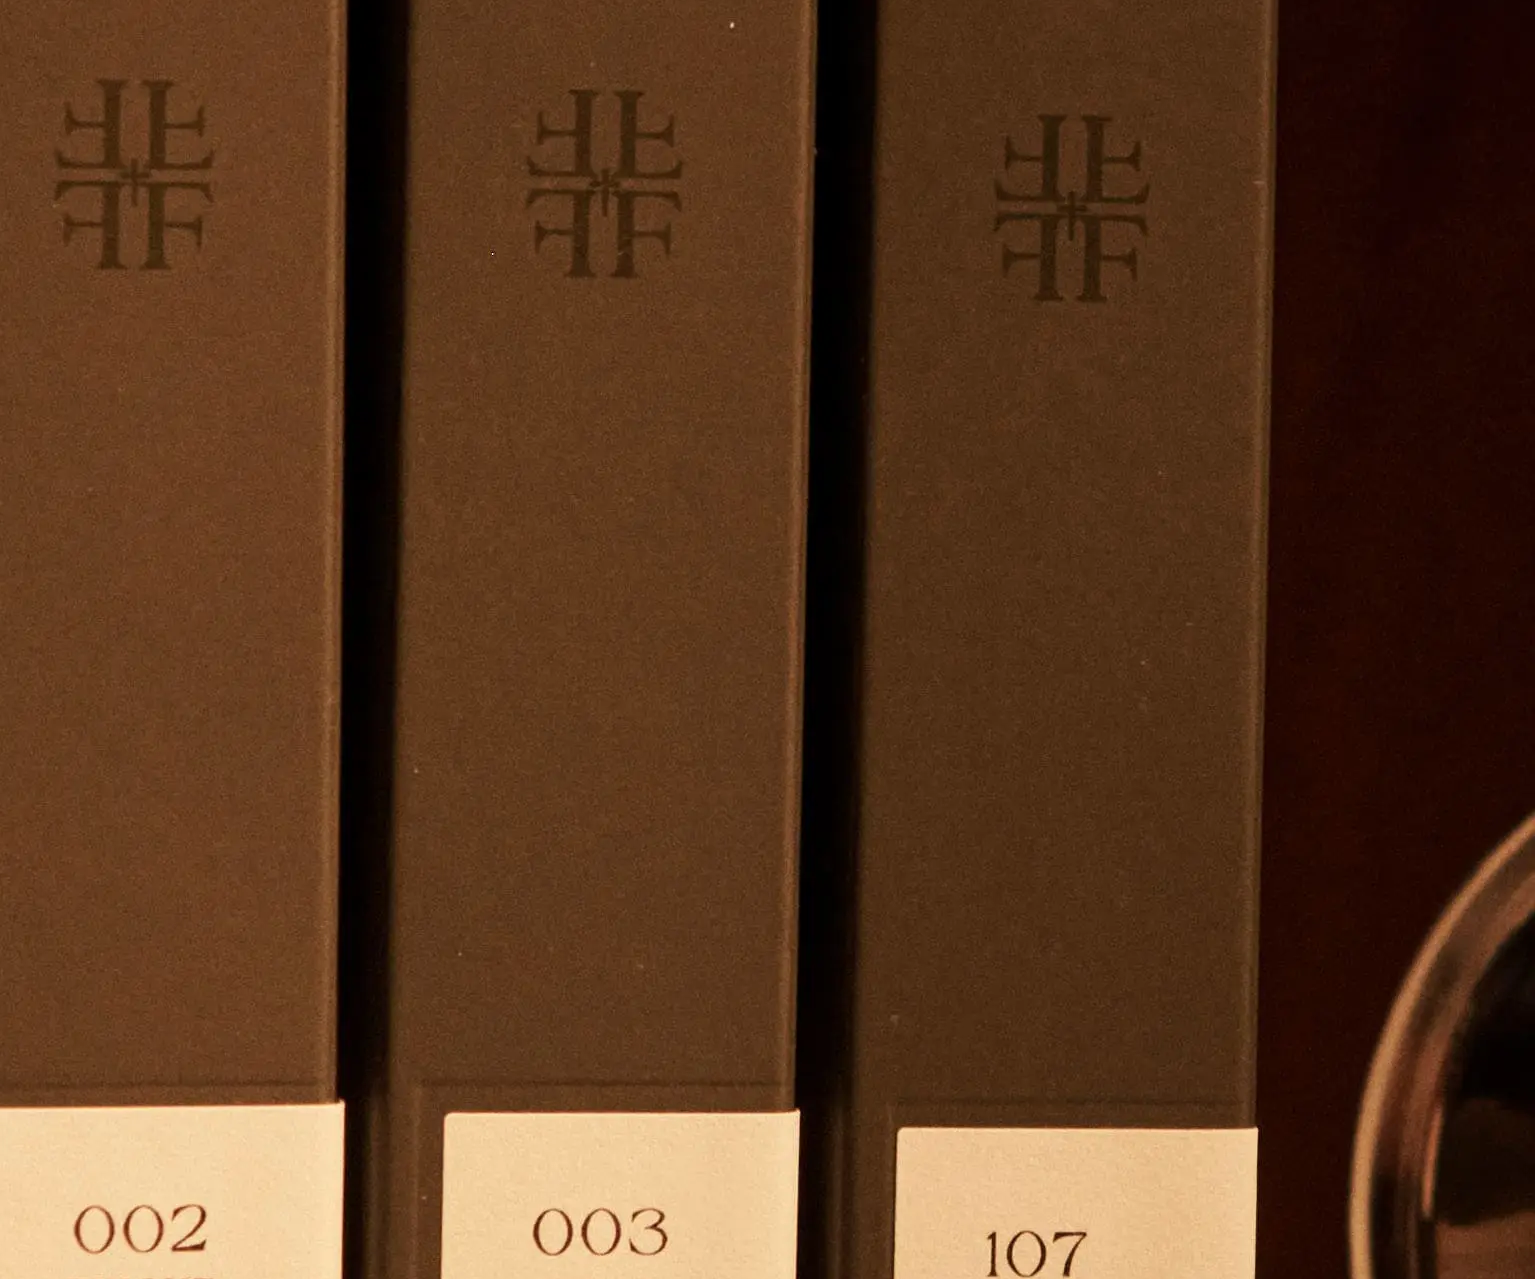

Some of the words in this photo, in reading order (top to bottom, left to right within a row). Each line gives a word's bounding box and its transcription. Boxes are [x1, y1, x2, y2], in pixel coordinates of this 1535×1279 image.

[72, 1203, 208, 1255] 002
[532, 1206, 669, 1257] 003
[986, 1229, 1089, 1279] 107
